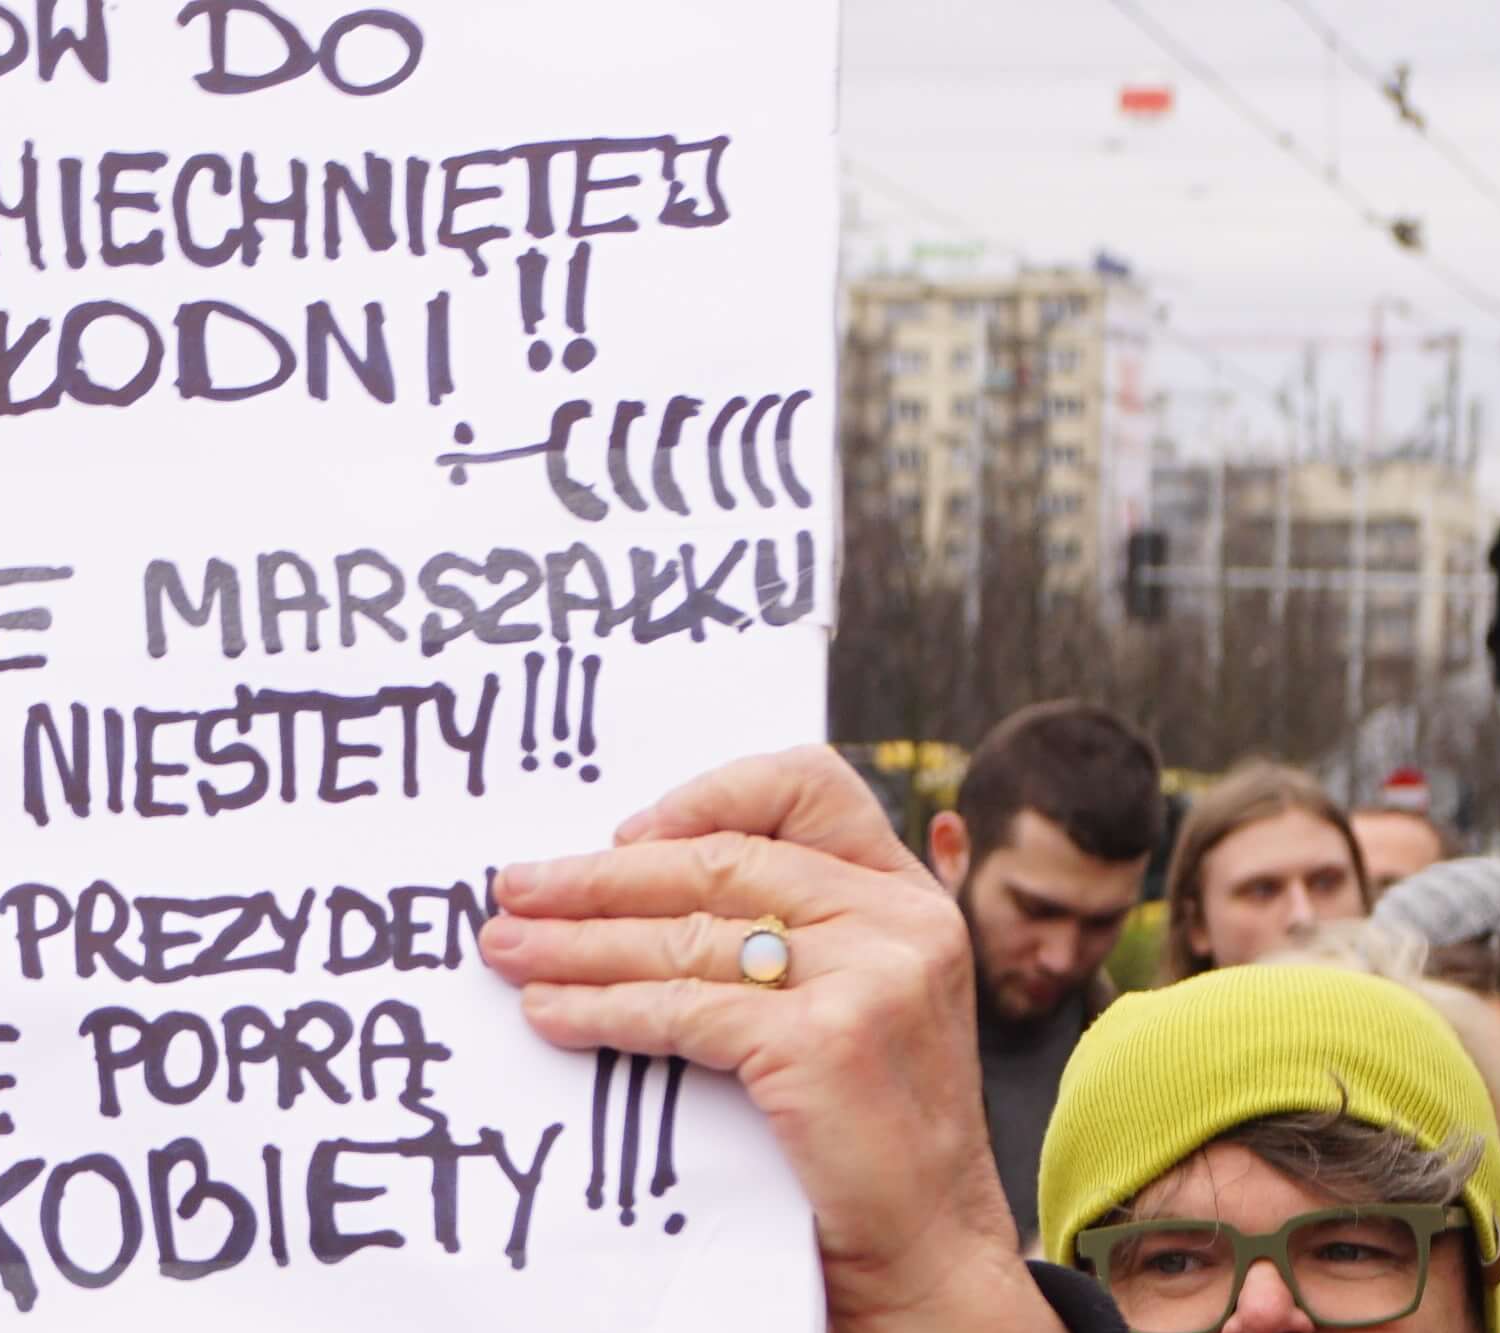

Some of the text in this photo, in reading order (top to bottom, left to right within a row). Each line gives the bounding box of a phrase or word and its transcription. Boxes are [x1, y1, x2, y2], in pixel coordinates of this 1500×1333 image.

[177, 0, 422, 96] DO
[145, 532, 813, 658] MARSZAŁKU
[79, 1000, 452, 1142] POPRĄ
